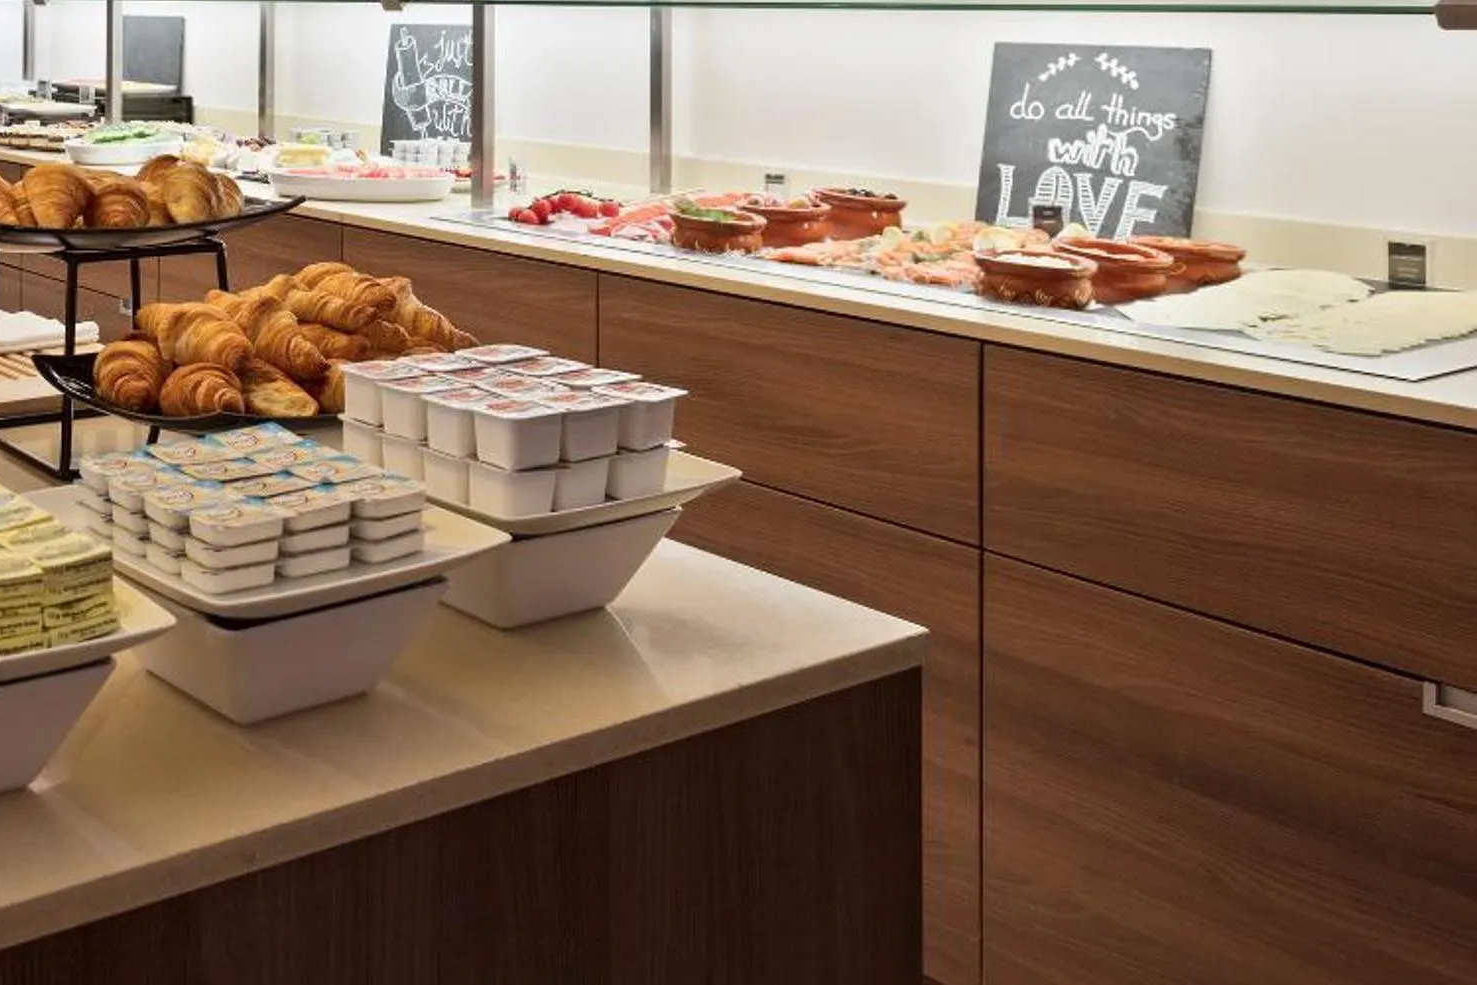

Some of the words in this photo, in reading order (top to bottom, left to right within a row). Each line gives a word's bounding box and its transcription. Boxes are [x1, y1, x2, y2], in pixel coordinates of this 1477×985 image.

[1010, 82, 1045, 120] do
[1055, 91, 1094, 121] all
[1100, 93, 1177, 141] things
[1048, 124, 1139, 176] with
